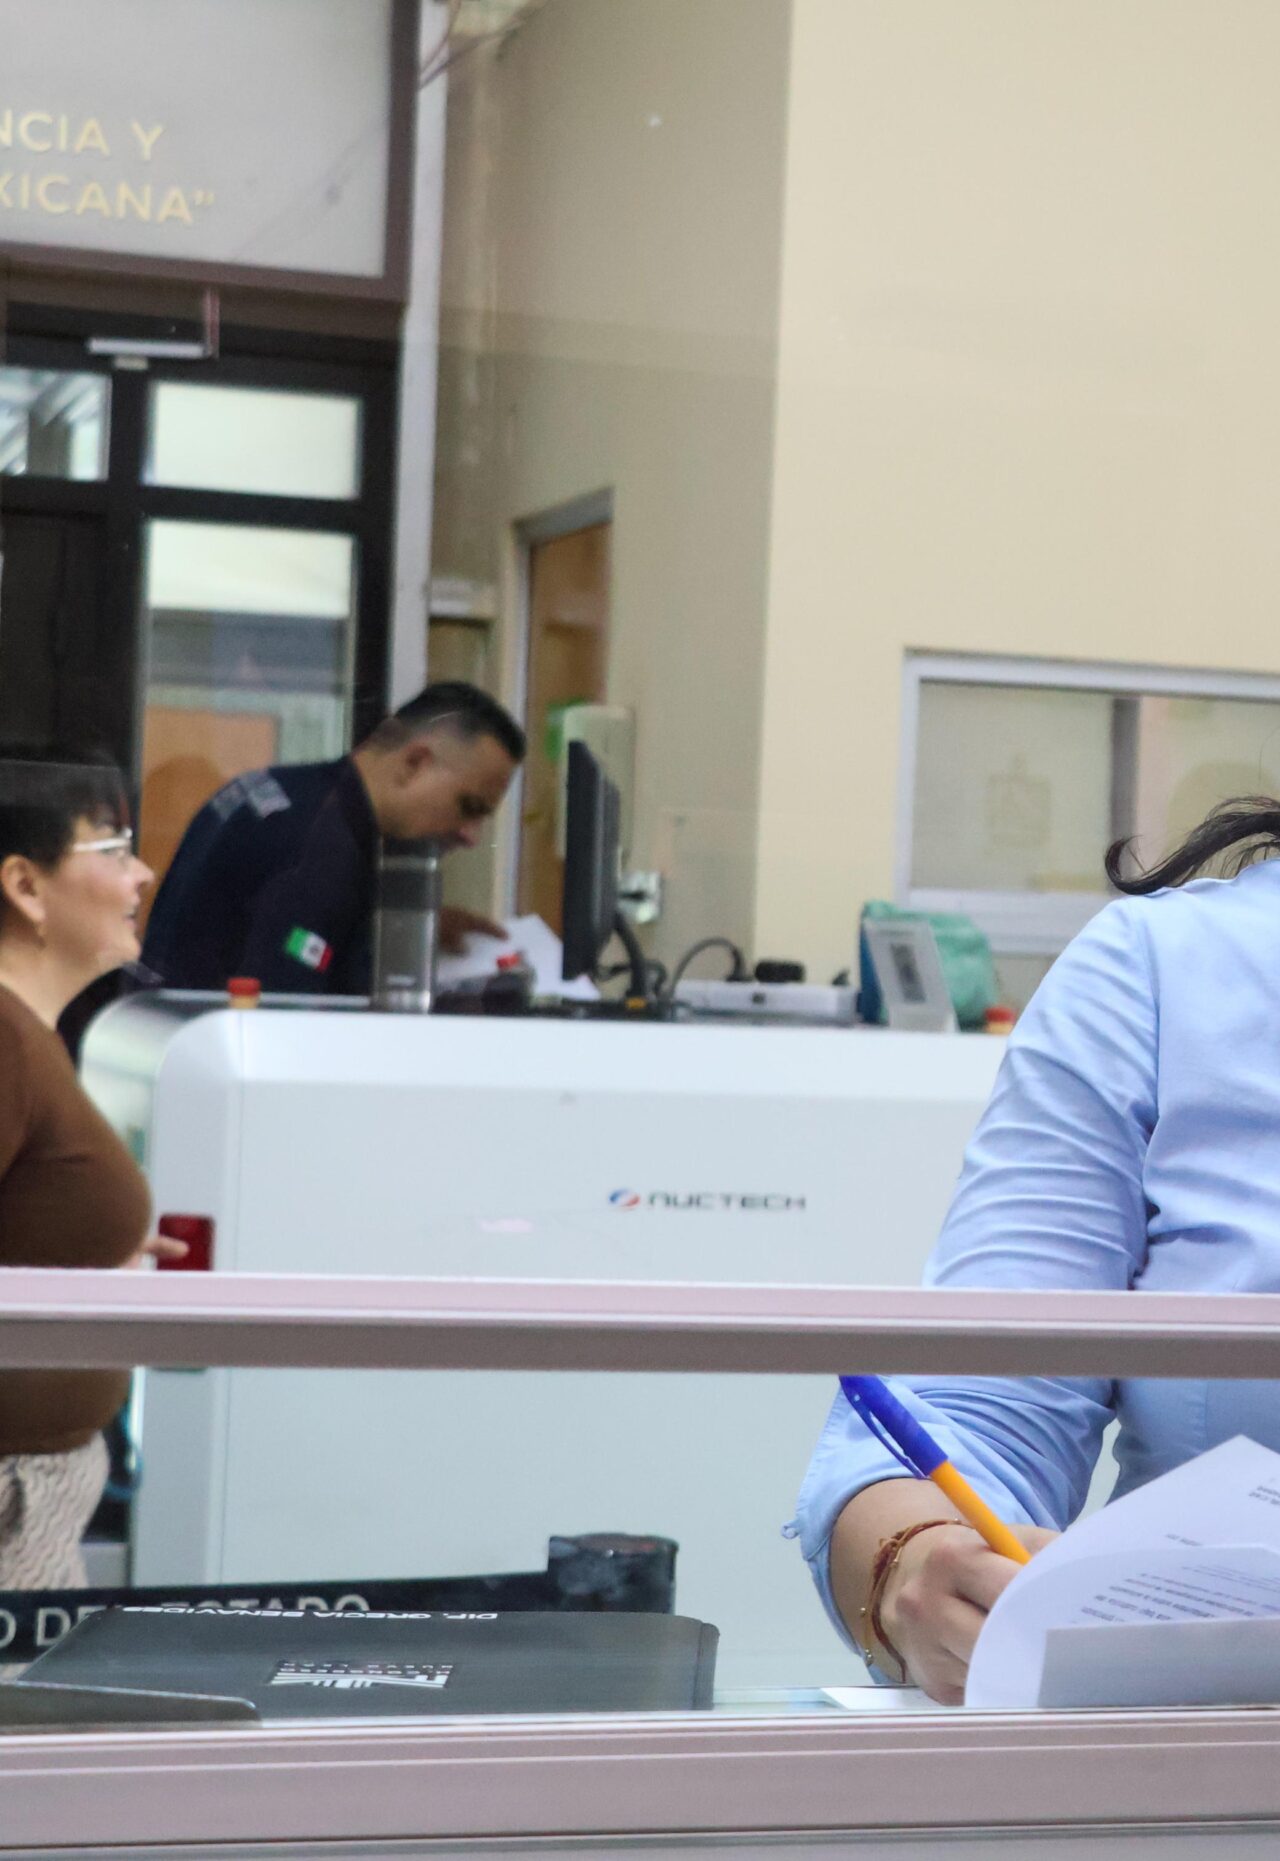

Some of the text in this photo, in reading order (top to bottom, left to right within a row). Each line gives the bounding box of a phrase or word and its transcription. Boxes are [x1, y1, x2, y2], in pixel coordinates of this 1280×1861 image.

[131, 120, 164, 161] Y
[648, 1191, 806, 1210] NUCTECH
[122, 1606, 305, 1618] BENAVIDES
[313, 1611, 432, 1619] GRECIA
